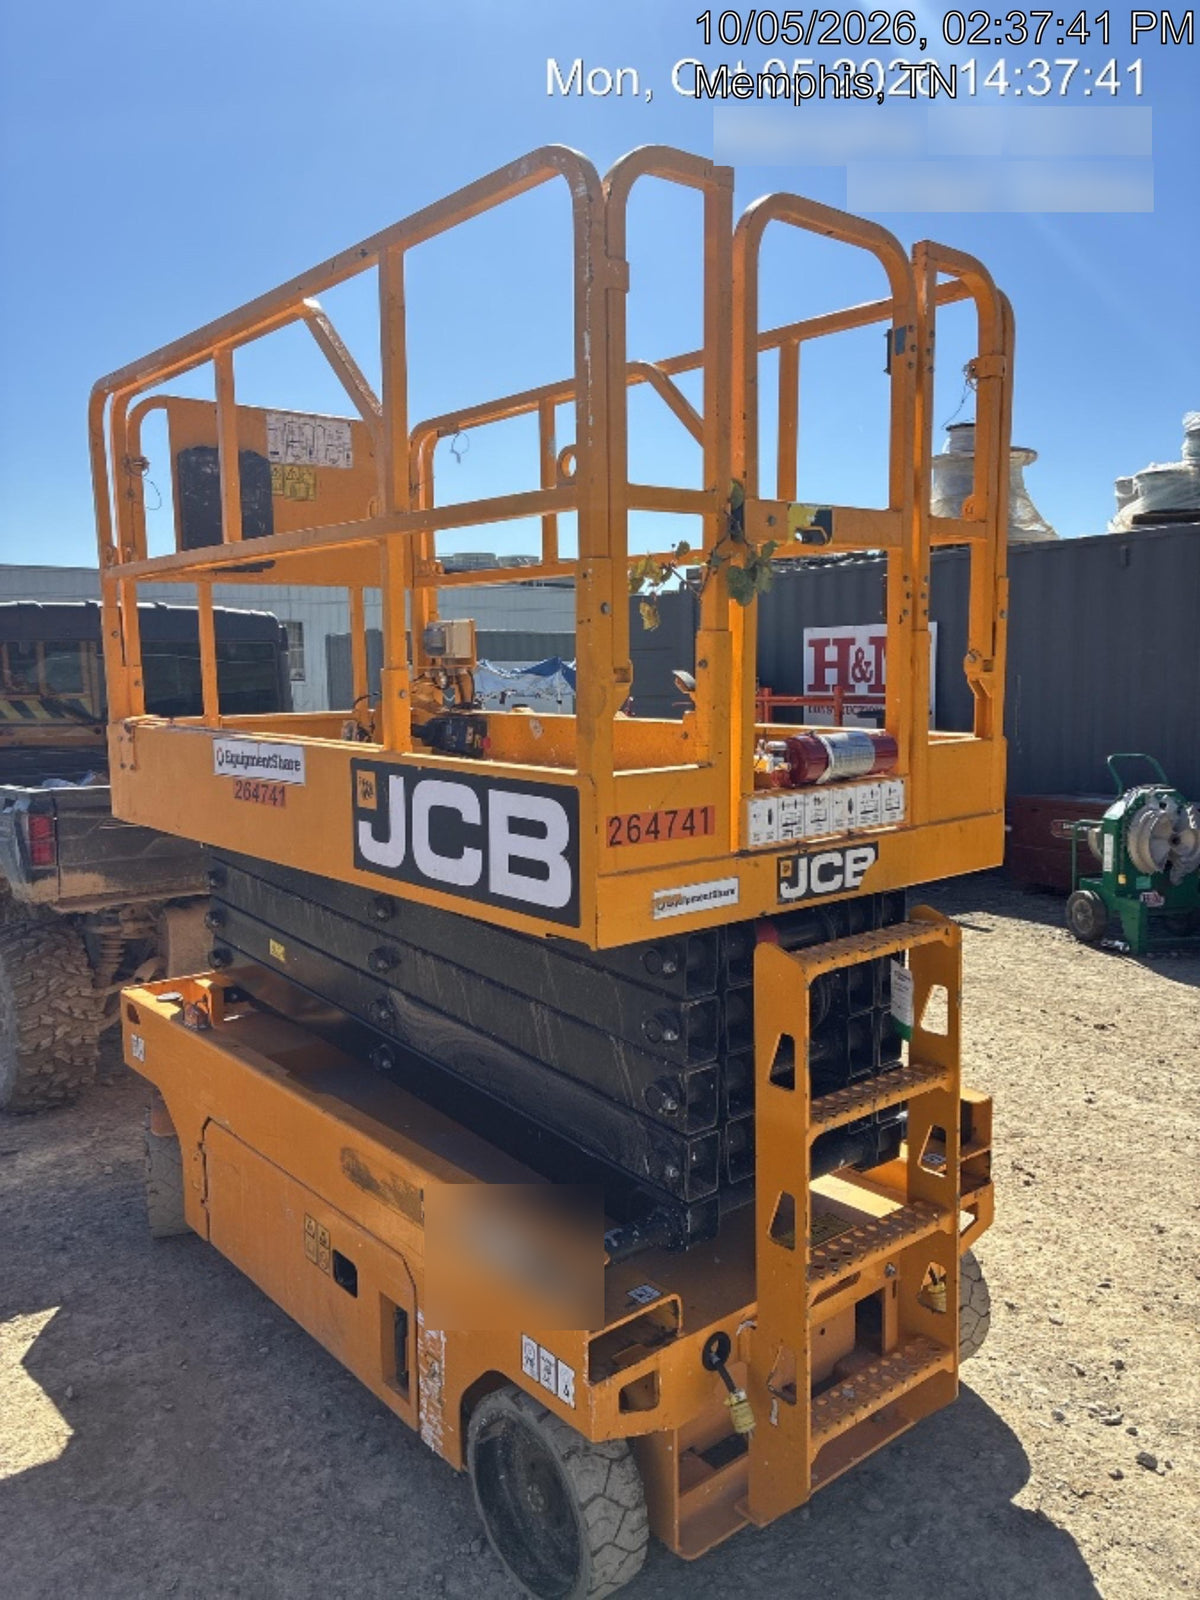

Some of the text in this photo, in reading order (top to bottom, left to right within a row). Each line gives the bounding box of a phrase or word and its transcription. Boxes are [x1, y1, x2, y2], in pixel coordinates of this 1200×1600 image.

[225, 749, 301, 772] EquipmentShare
[233, 779, 287, 807] 264741
[358, 773, 572, 909] JCB
[608, 806, 712, 847] 264741
[780, 847, 875, 899] JCB
